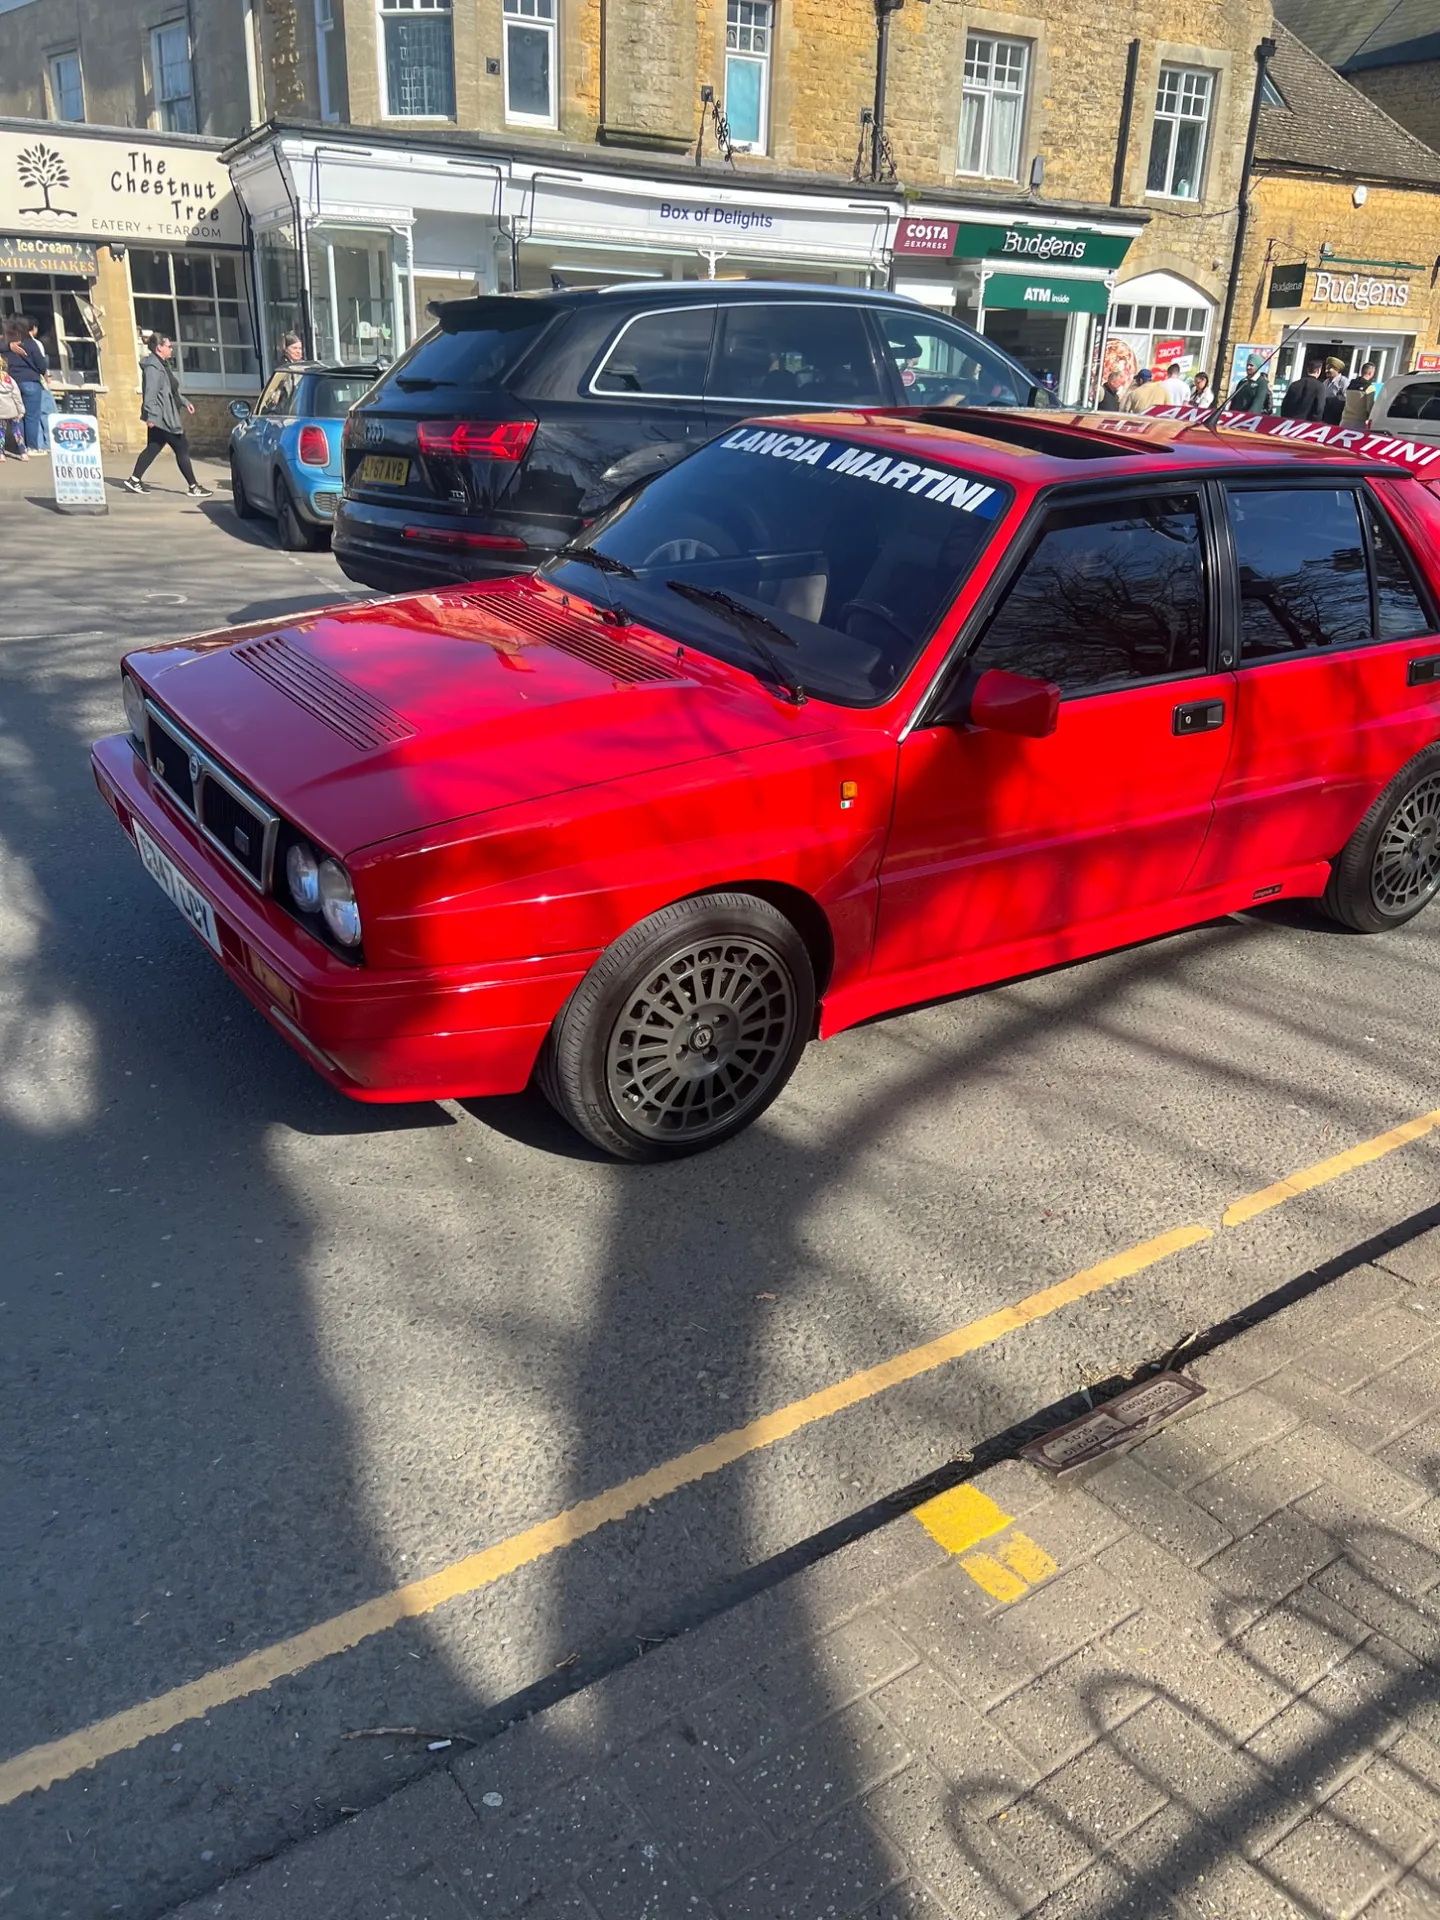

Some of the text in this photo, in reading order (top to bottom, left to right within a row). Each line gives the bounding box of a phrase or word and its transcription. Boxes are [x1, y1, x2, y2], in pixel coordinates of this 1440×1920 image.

[128, 151, 166, 174] The
[110, 171, 217, 199] Chestnut
[171, 200, 220, 221] Tree
[660, 203, 773, 229] Box of Delights
[91, 218, 141, 233] EATERY
[159, 223, 222, 238] TEAROOM
[906, 224, 949, 240] COSTA
[15, 238, 73, 254] Ice Cream
[910, 240, 947, 250] EXPRESS
[1002, 231, 1086, 259] Budgens
[0, 257, 95, 274] MILK SHAKES
[1024, 287, 1070, 304] ATM inside
[1271, 281, 1302, 293] Budgens
[1313, 272, 1409, 310] Budgens
[1267, 418, 1440, 466] MARTINI
[55, 466, 102, 480] FOR DOGS
[720, 429, 996, 512] LANCIA MARTINI
